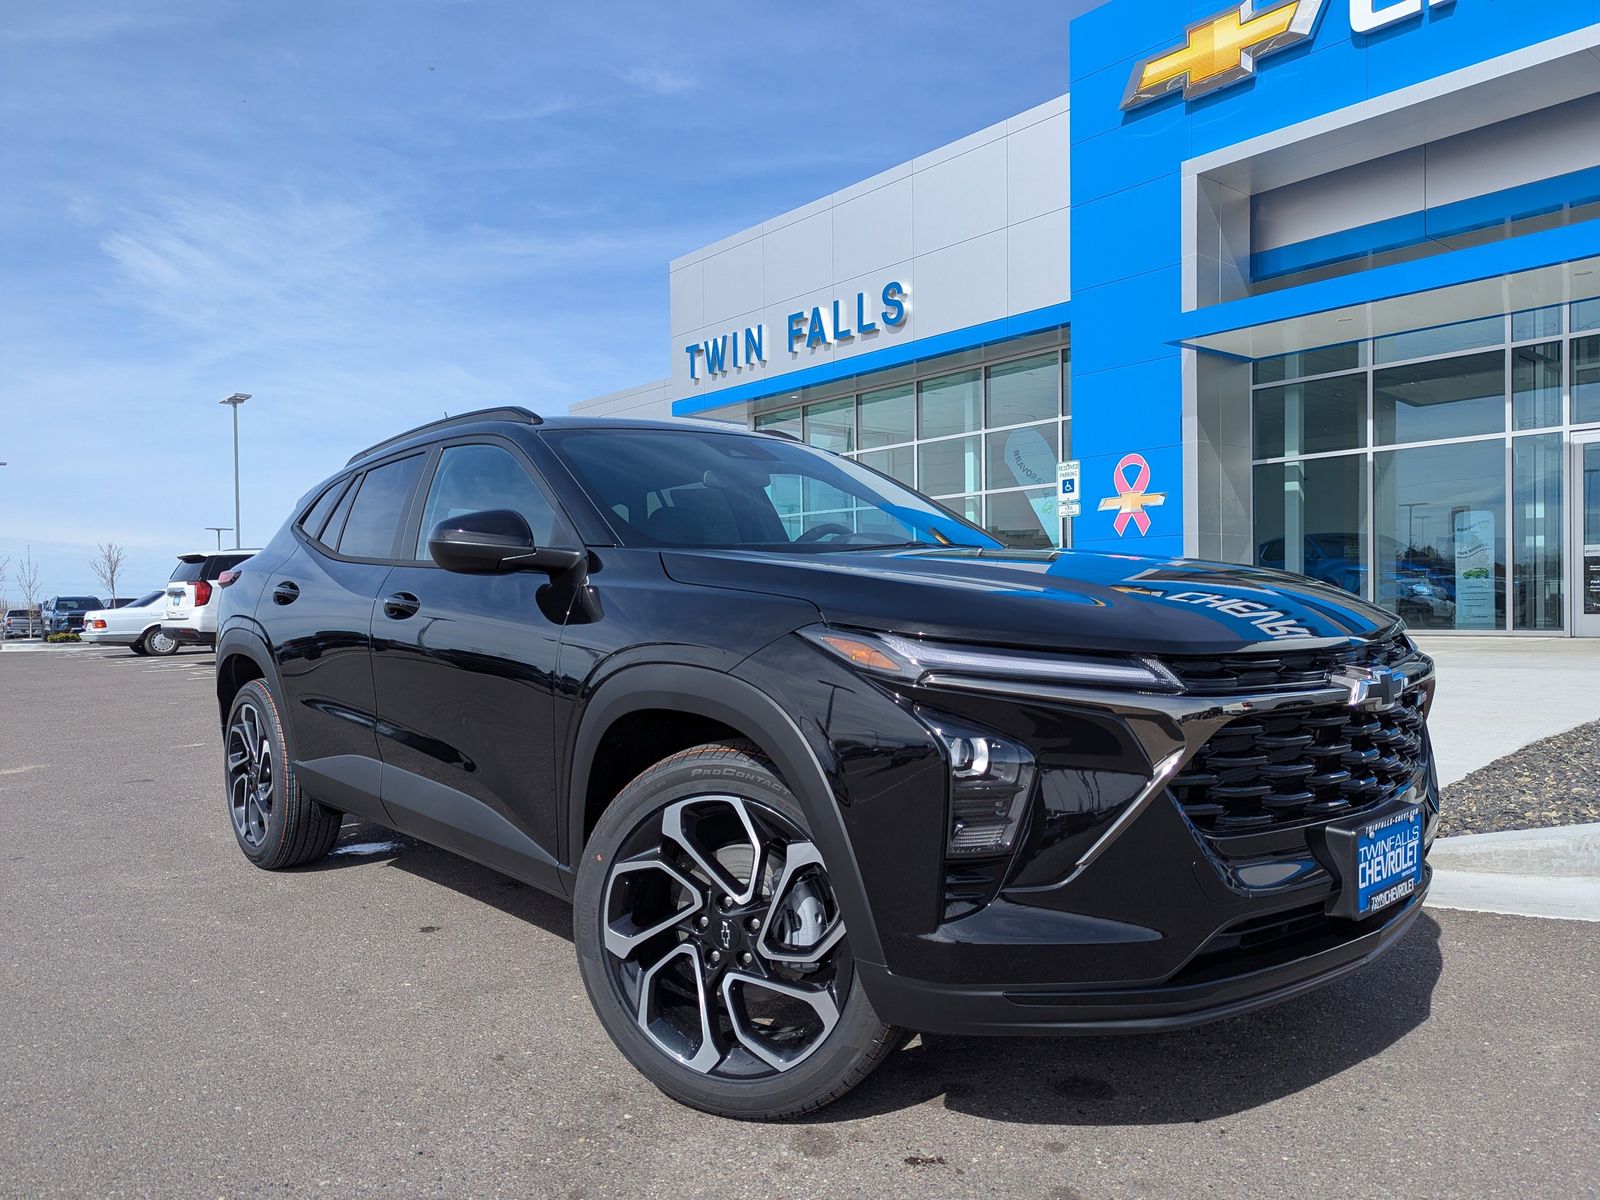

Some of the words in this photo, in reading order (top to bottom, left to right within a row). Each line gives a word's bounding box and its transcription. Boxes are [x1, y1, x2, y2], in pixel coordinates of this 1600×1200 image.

[685, 324, 766, 381] TWIN
[787, 281, 907, 354] FALLS
[1058, 462, 1078, 471] RESERVED
[1358, 840, 1419, 889] CHEVROLET
[1384, 877, 1415, 905] CHEVROLET
